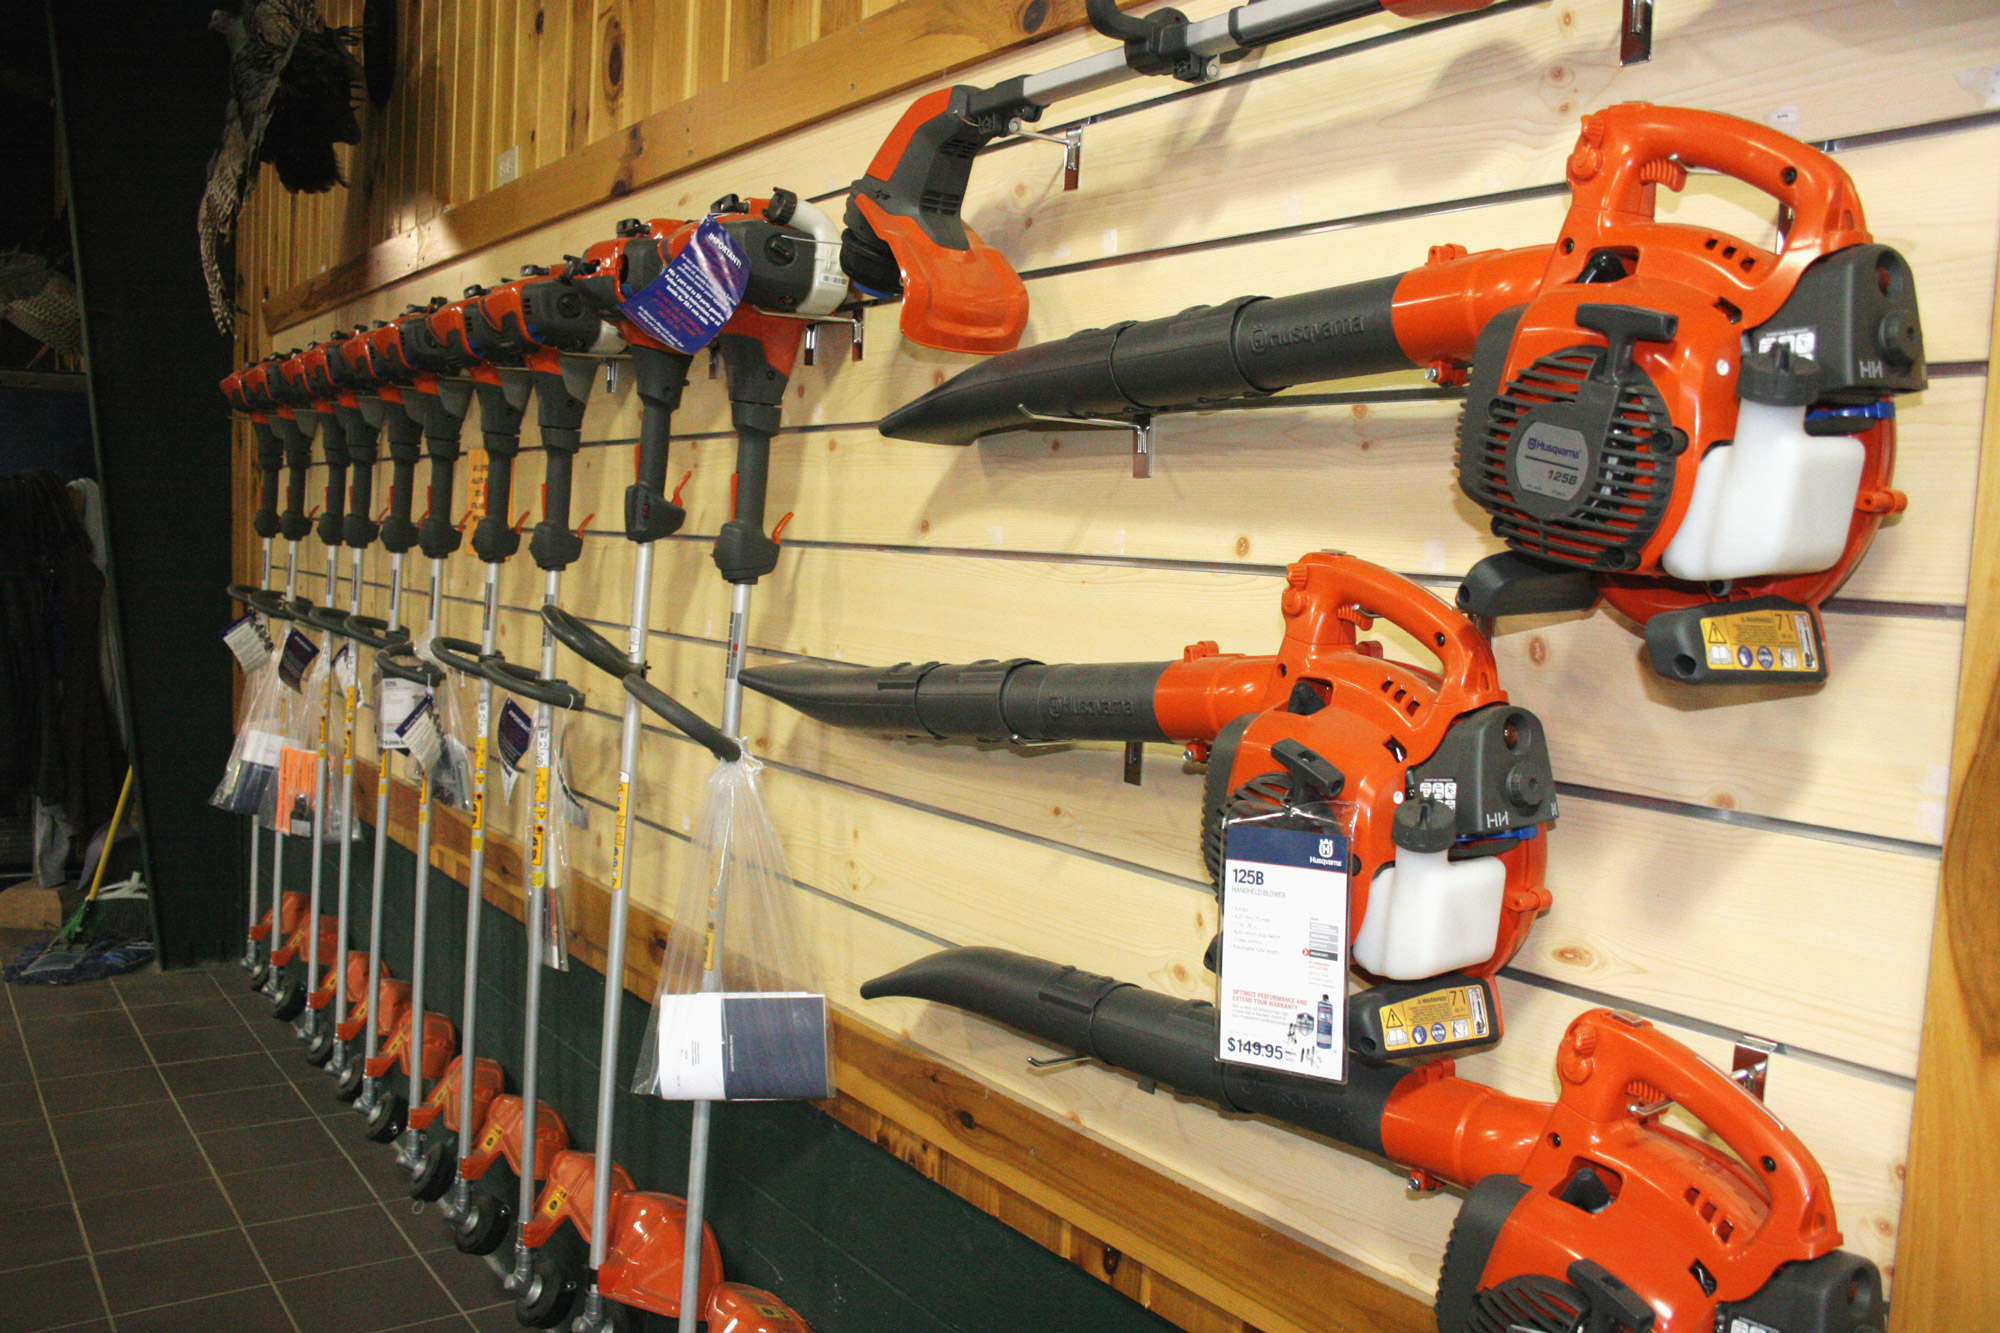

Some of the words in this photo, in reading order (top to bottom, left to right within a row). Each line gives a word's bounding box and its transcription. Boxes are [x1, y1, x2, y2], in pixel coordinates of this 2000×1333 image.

[707, 232, 743, 268] IMPORTANT!
[664, 273, 678, 287] Follow
[667, 267, 676, 276] Mix
[676, 277, 687, 287] part
[699, 297, 710, 309] parts
[1269, 314, 1365, 347] Husqvarna
[1536, 440, 1580, 460] Husqvarna
[1547, 469, 1578, 485] 125B
[1063, 695, 1135, 717] Husqvarna
[1309, 856, 1342, 867] Husqvarna
[1232, 868, 1264, 885] 125B
[1232, 886, 1262, 896] HANDHELD
[1263, 889, 1287, 899] BLOWER
[1232, 989, 1256, 997] OPTIMIZE
[1257, 992, 1295, 1004] PERFORMANCE
[1232, 995, 1253, 1004] EXTEND
[1269, 1000, 1298, 1010] WARRANTY
[1227, 1036, 1283, 1060] $149.95
